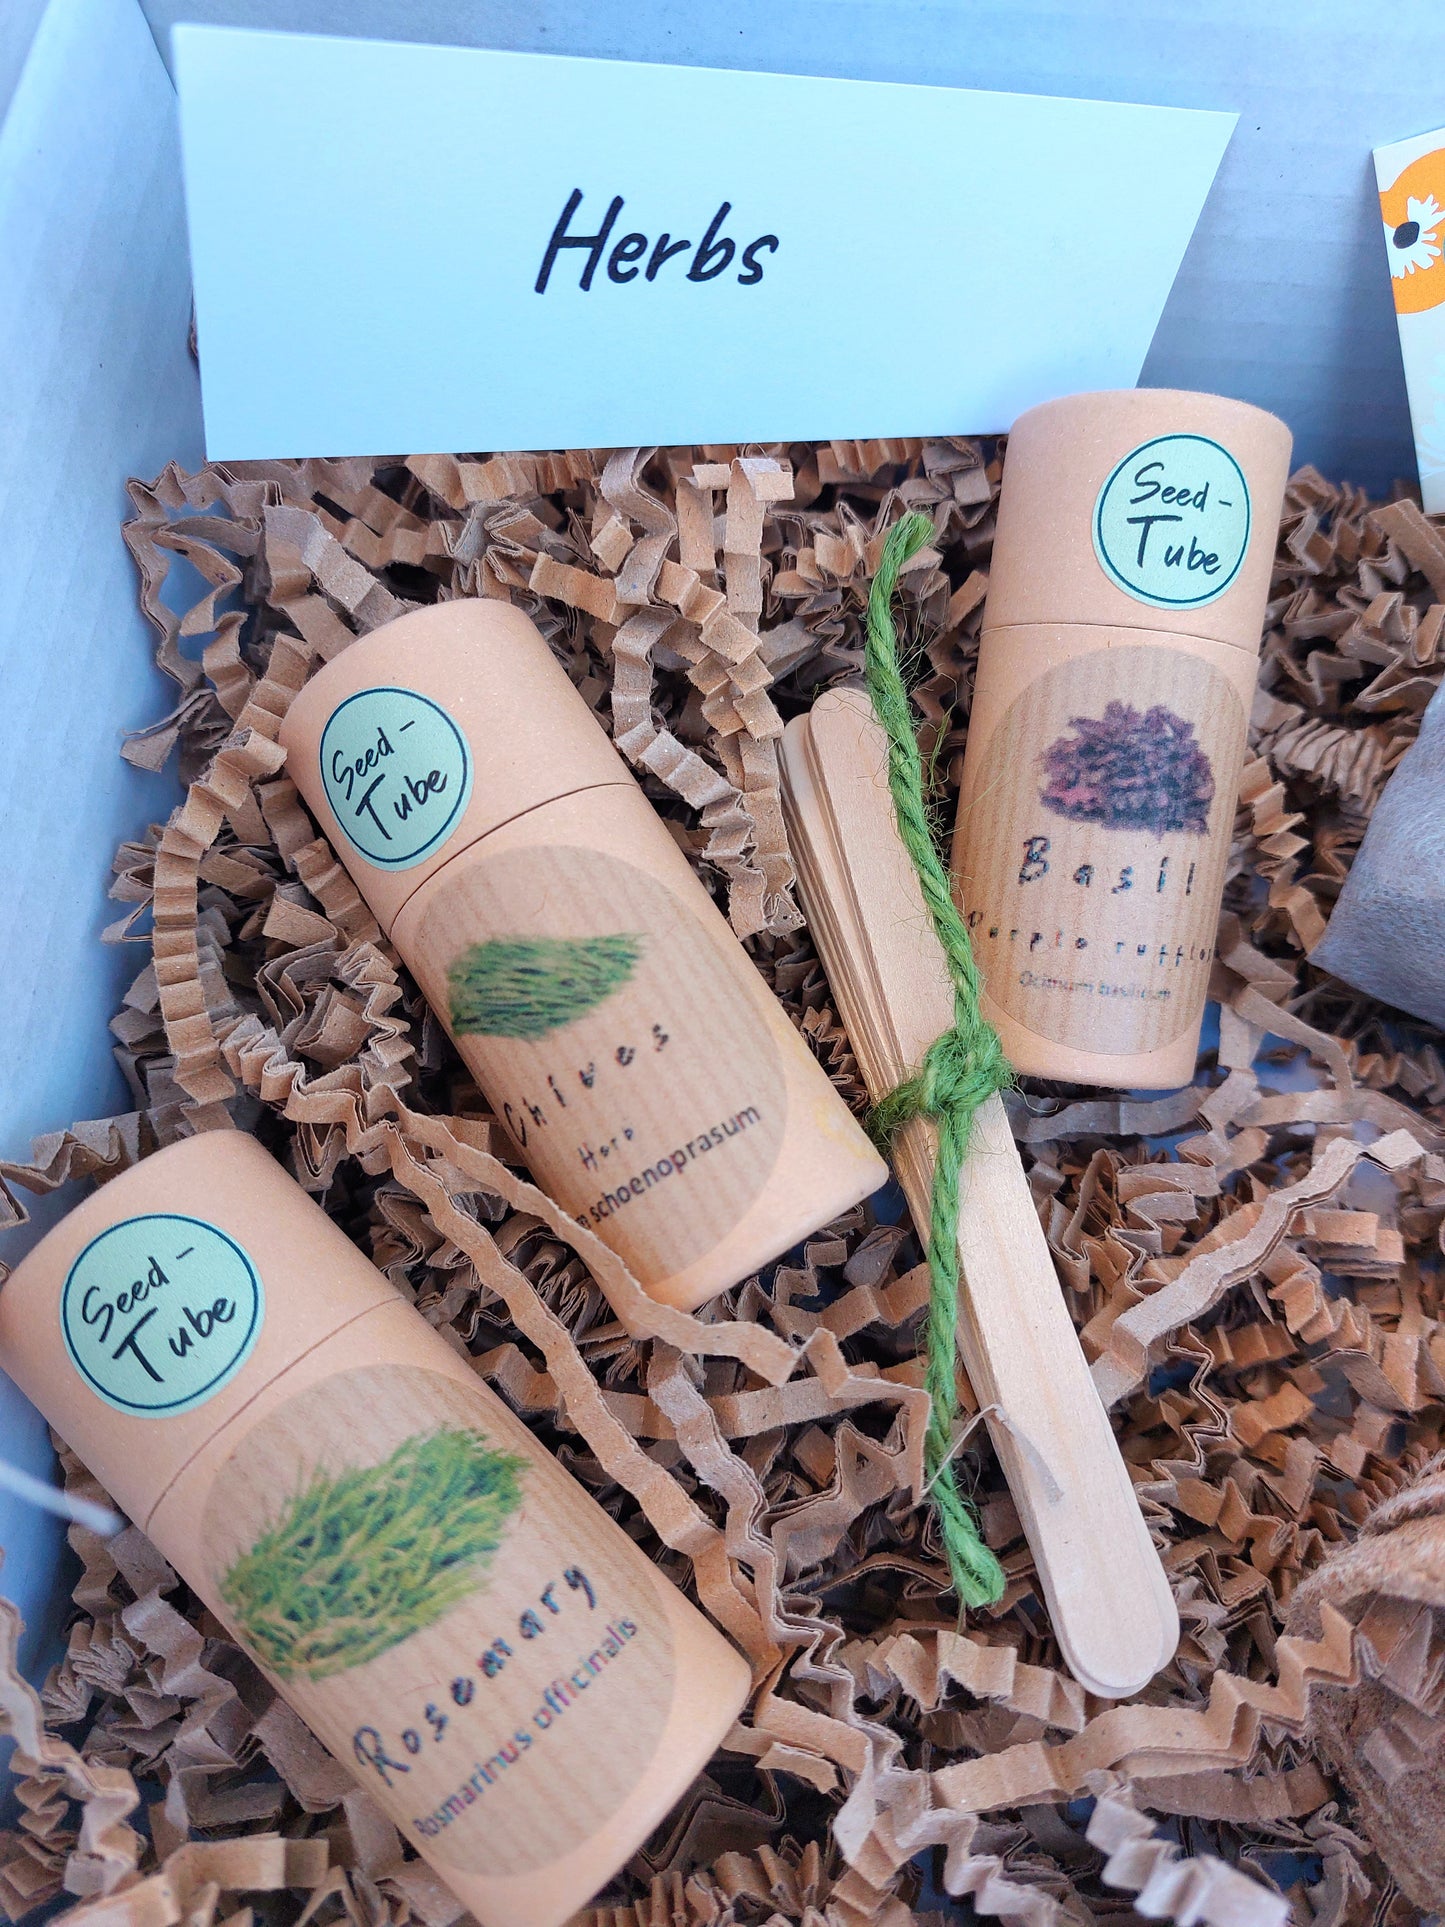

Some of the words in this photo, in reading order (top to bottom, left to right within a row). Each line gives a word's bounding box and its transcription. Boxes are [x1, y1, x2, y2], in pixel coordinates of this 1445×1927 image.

[534, 188, 779, 294] Herbs
[1127, 515, 1222, 575] Tube
[355, 773, 447, 840] Tube
[1018, 836, 1196, 896] Basil
[504, 1023, 669, 1148] Chives
[588, 1105, 762, 1223] schoenoprasum
[112, 1298, 236, 1383] Tube
[353, 1565, 597, 1788] Rosemary
[412, 1729, 533, 1838] Rosmarinus
[533, 1617, 638, 1730] officinalis
